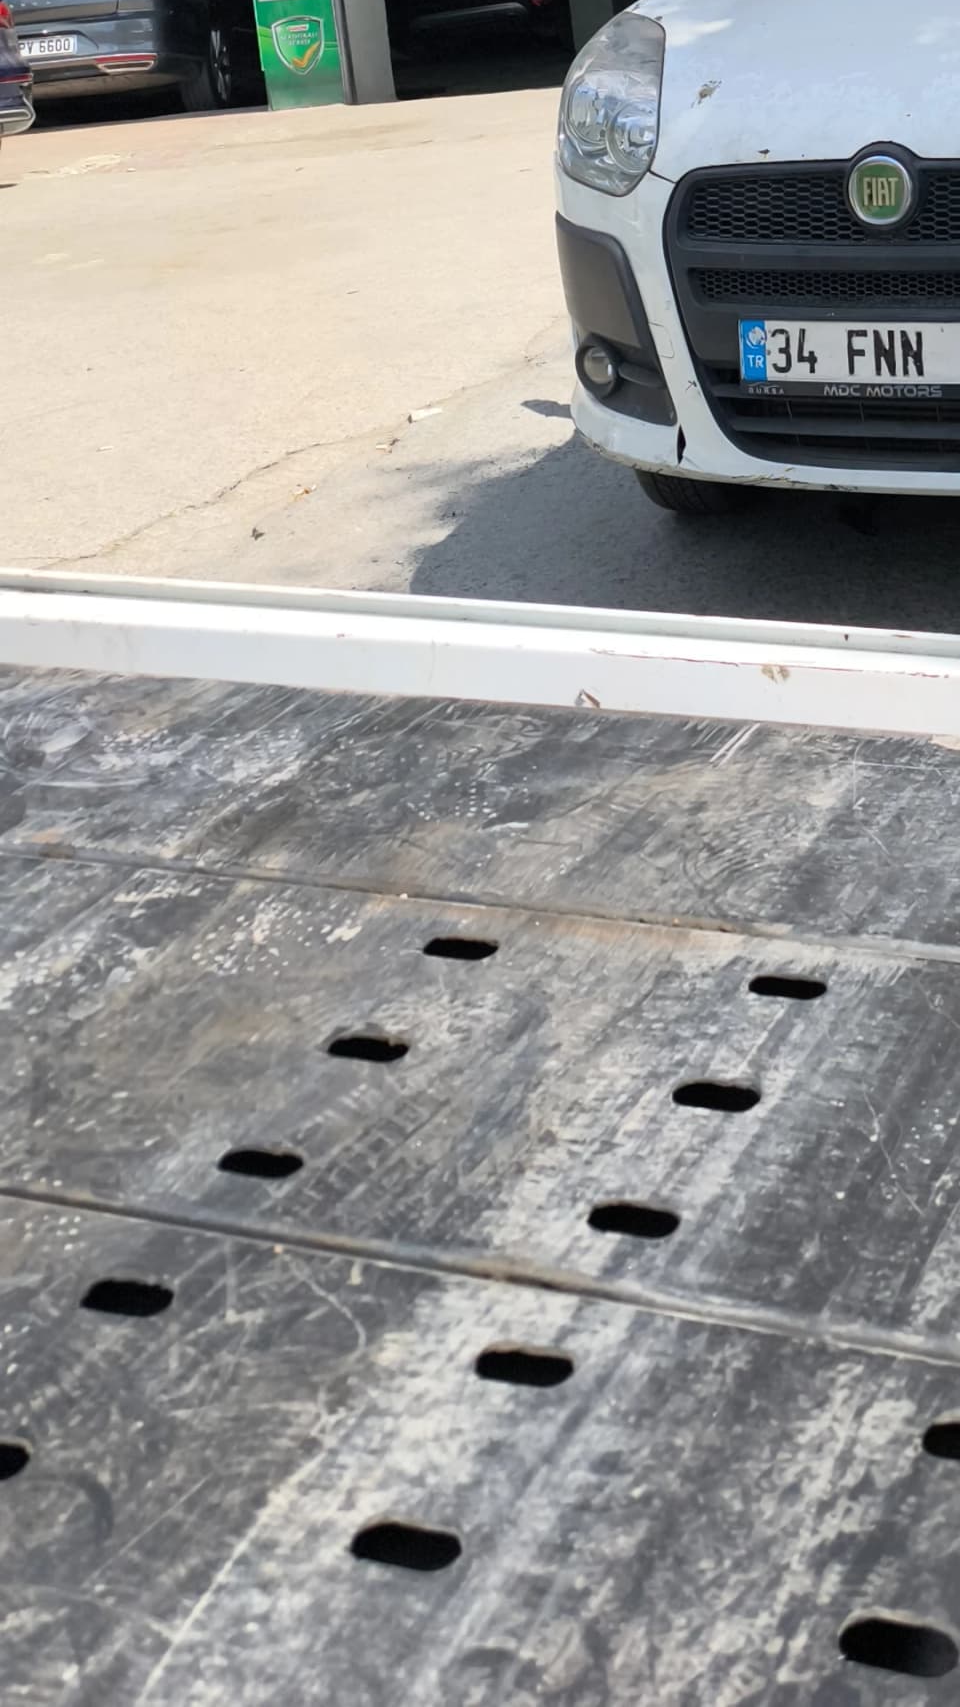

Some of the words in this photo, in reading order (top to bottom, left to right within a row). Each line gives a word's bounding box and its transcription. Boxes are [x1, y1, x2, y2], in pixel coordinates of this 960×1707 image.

[39, 38, 71, 53] 6600
[862, 176, 899, 207] FIAT
[770, 327, 818, 374] 34
[846, 329, 925, 377] FNN
[747, 354, 765, 368] TR
[823, 384, 861, 397] MDC
[865, 385, 943, 398] MOTORS
